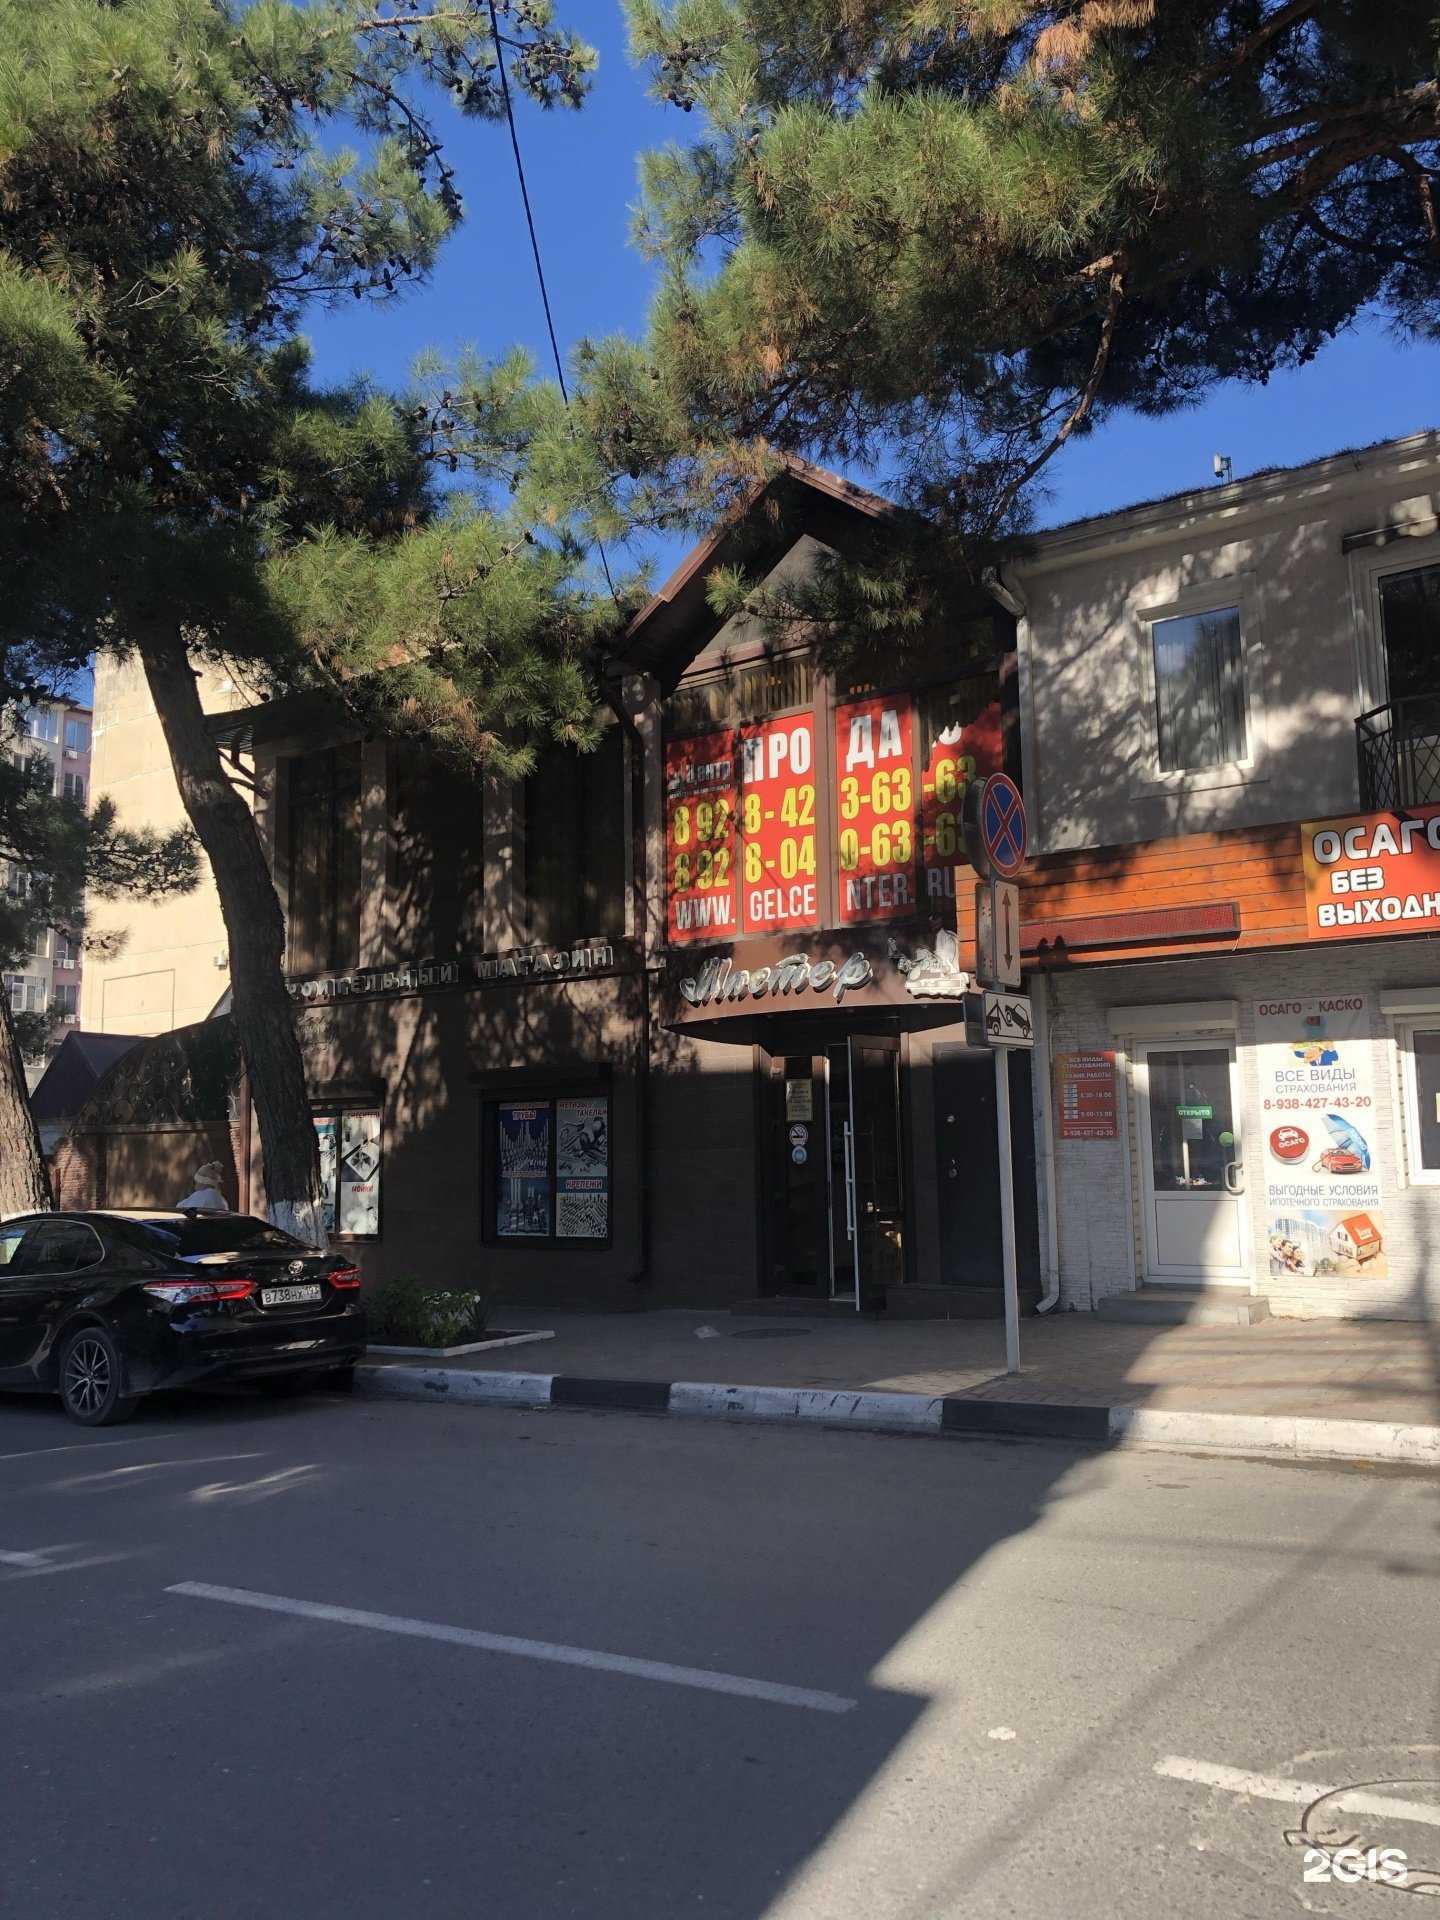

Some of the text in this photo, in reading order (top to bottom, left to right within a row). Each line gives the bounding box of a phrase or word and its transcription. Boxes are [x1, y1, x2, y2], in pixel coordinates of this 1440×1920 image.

[1330, 866, 1385, 894] БЕЗ
[477, 945, 614, 979] МАГАЗИН
[1259, 1002, 1301, 1016] ОСАГО
[1319, 998, 1363, 1013] КАСКО
[1275, 1068, 1355, 1083] ВСЕ ВИДЫ
[1275, 1082, 1357, 1094] СТРАХОВАНИЯ
[1263, 1096, 1372, 1110] 8-938-427-43-20
[1279, 1137, 1305, 1149] ОСАГО
[1269, 1184, 1378, 1197] ВЫГОДНЫЕ УСЛОВИЯ
[1269, 1198, 1379, 1207] ИПОТЕЧНОГО СТРАХОВАНИЯ
